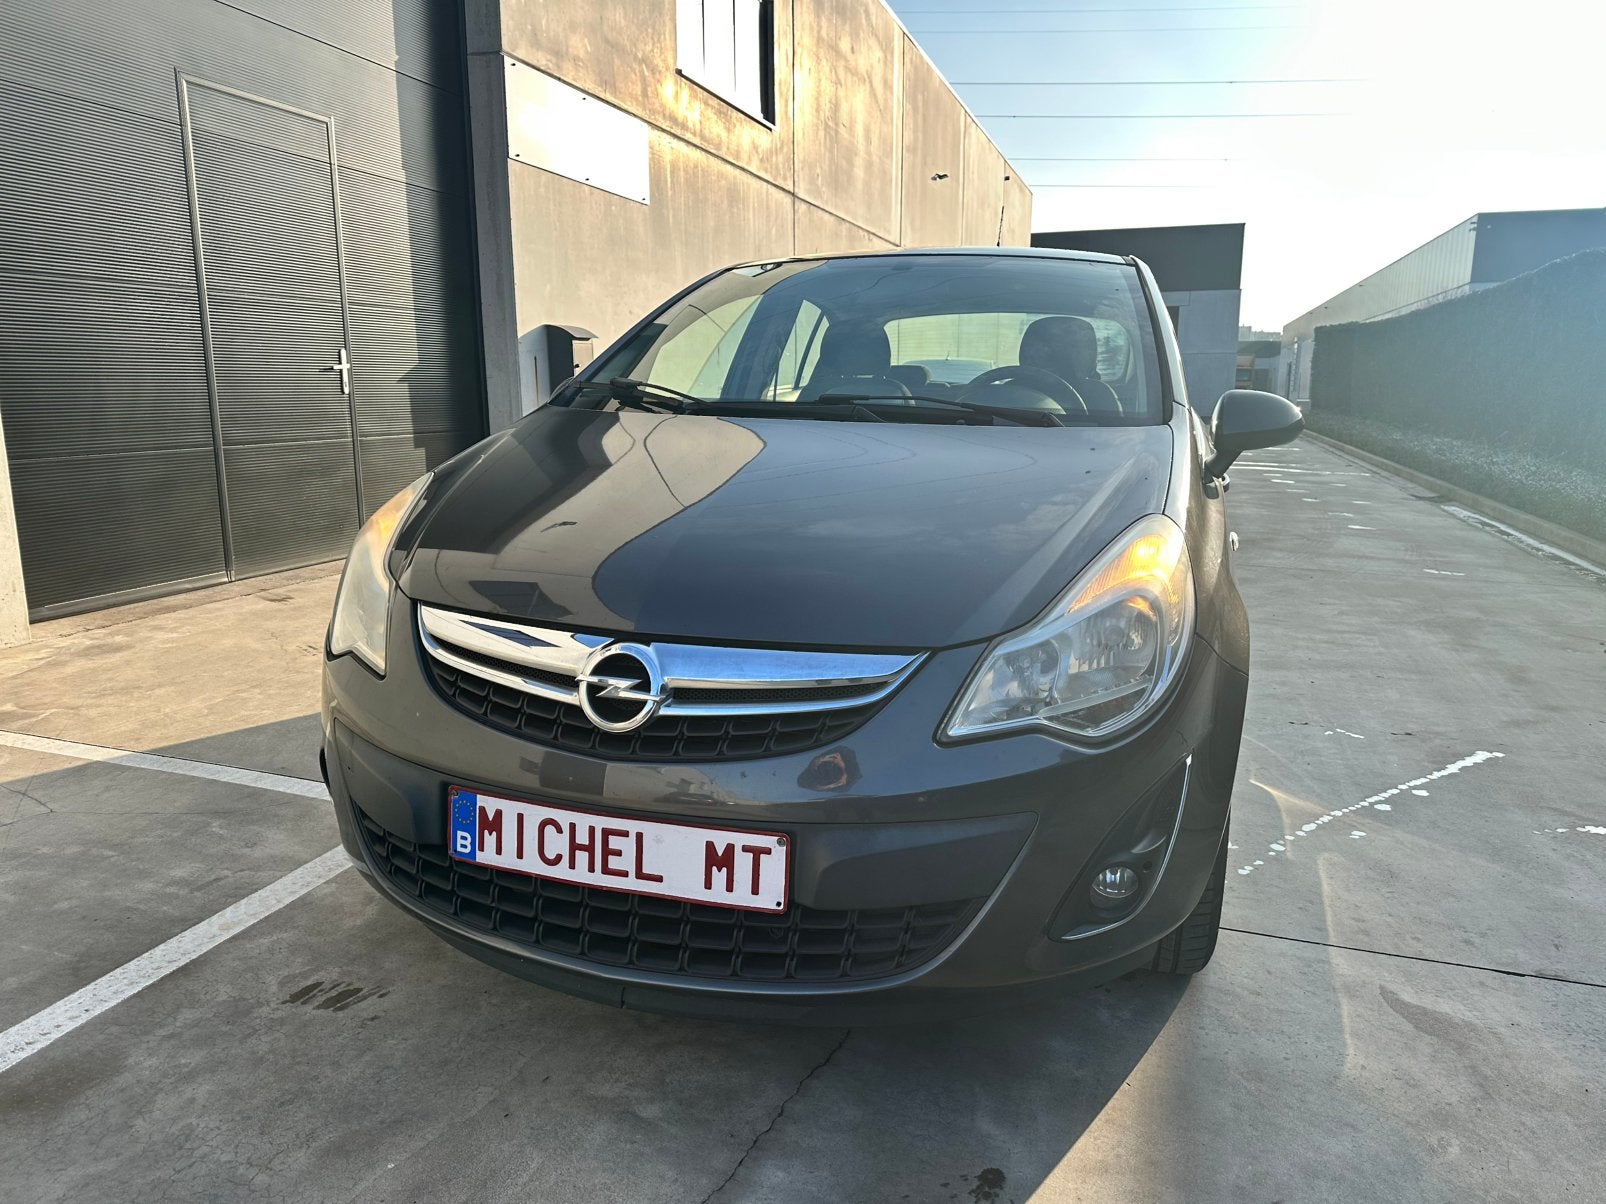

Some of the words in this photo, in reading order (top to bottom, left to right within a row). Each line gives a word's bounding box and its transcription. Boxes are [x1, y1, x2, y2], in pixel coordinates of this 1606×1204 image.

[456, 831, 472, 854] B
[478, 805, 664, 883] MICHEL
[704, 840, 772, 896] MT
